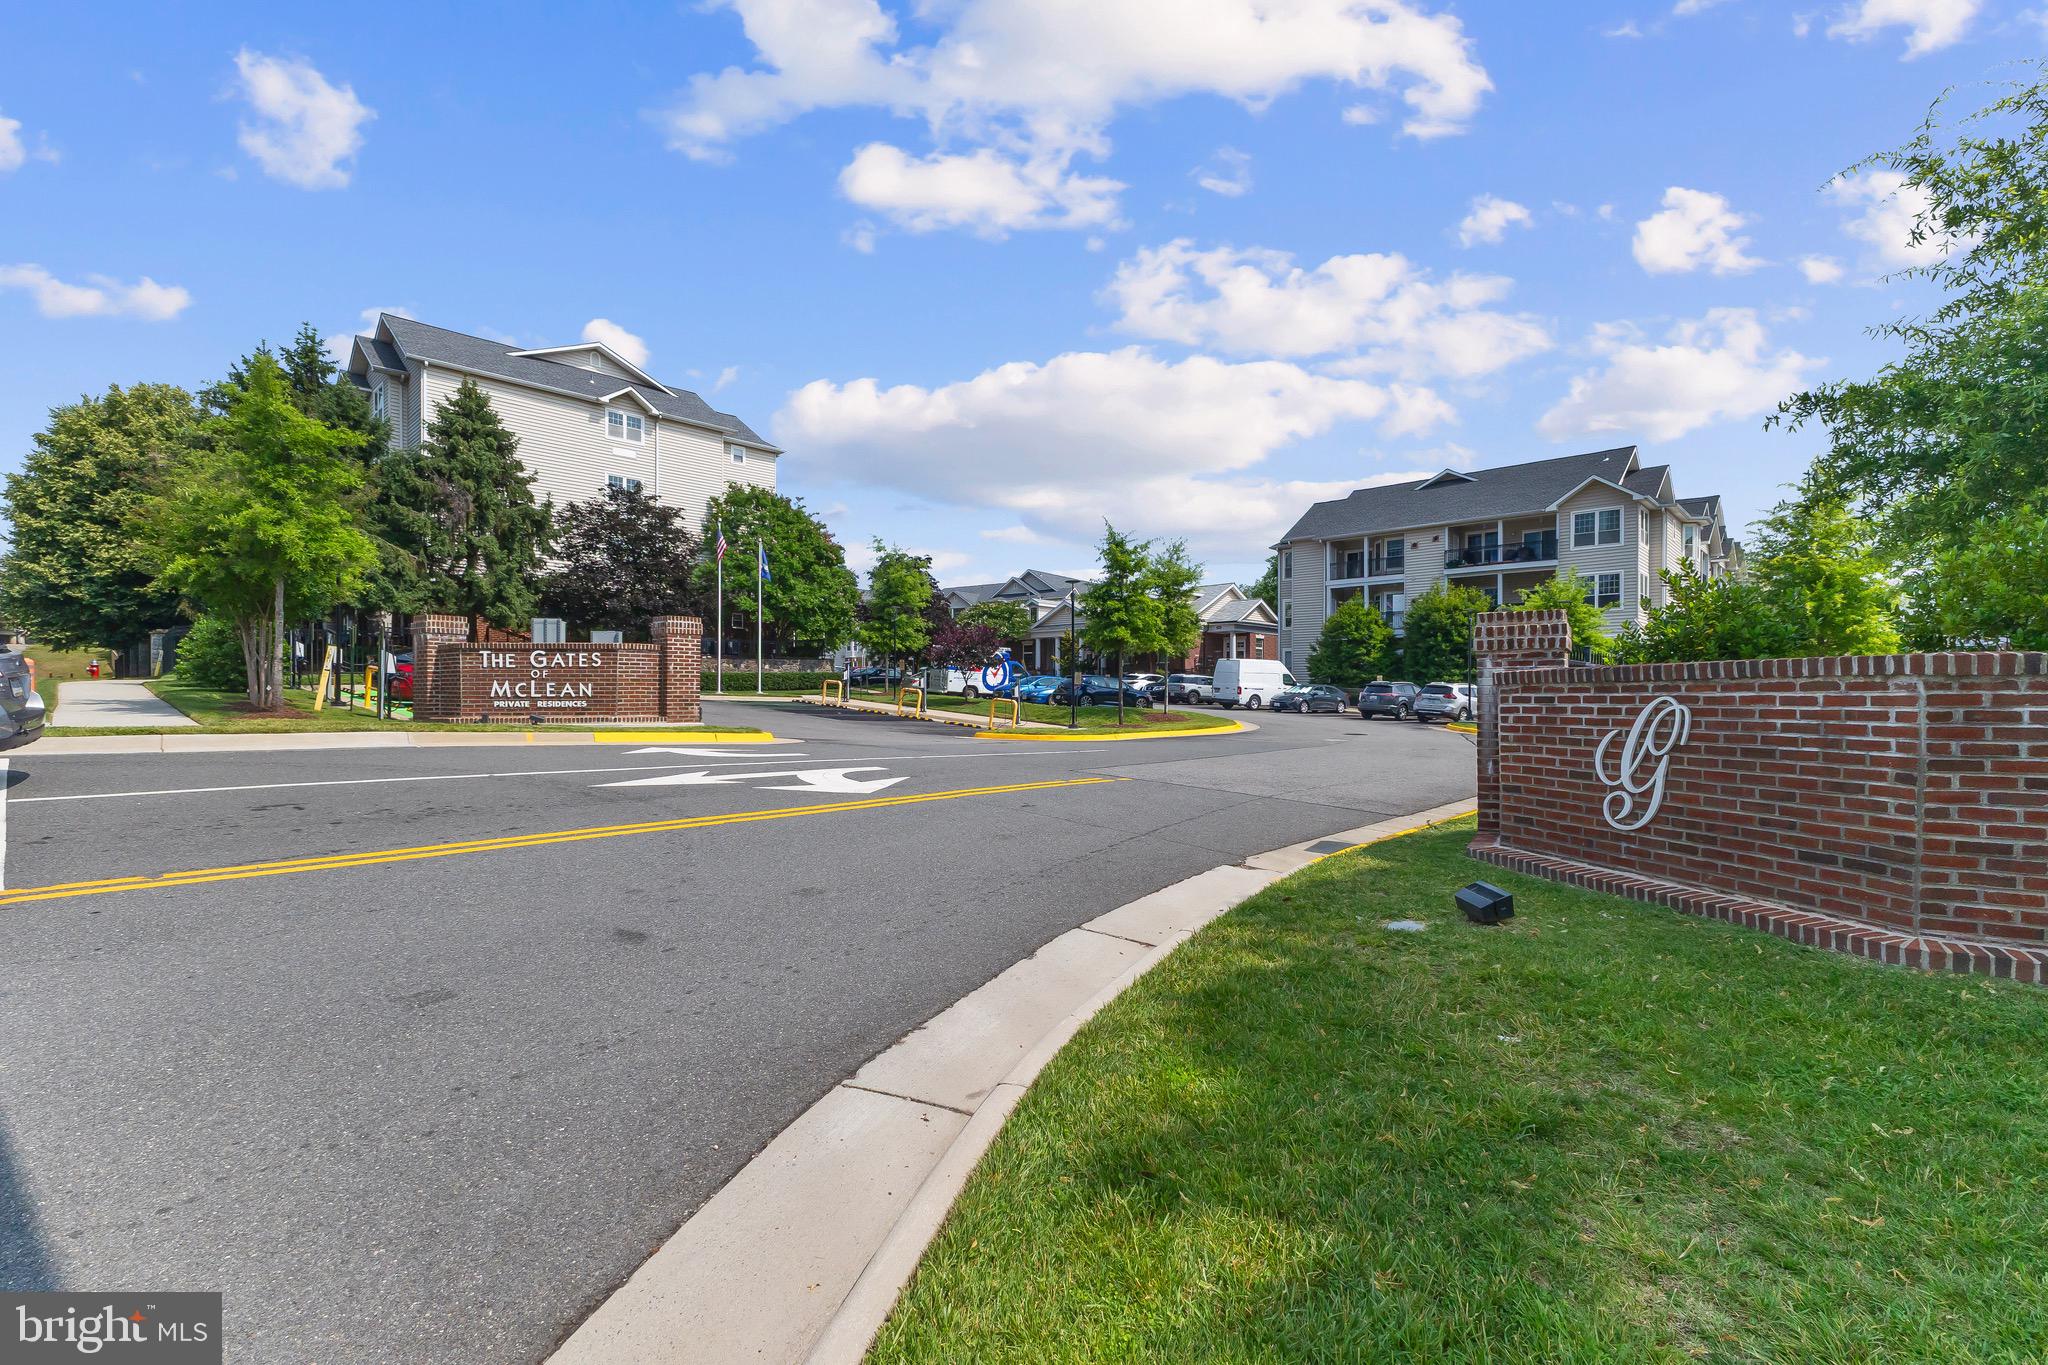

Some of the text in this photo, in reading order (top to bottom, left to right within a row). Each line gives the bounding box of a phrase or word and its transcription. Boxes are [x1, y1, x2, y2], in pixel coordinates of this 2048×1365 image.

[479, 650, 602, 668] THE GATES
[530, 669, 549, 679] OF
[493, 700, 588, 708] PRIVATE RESIDENCES
